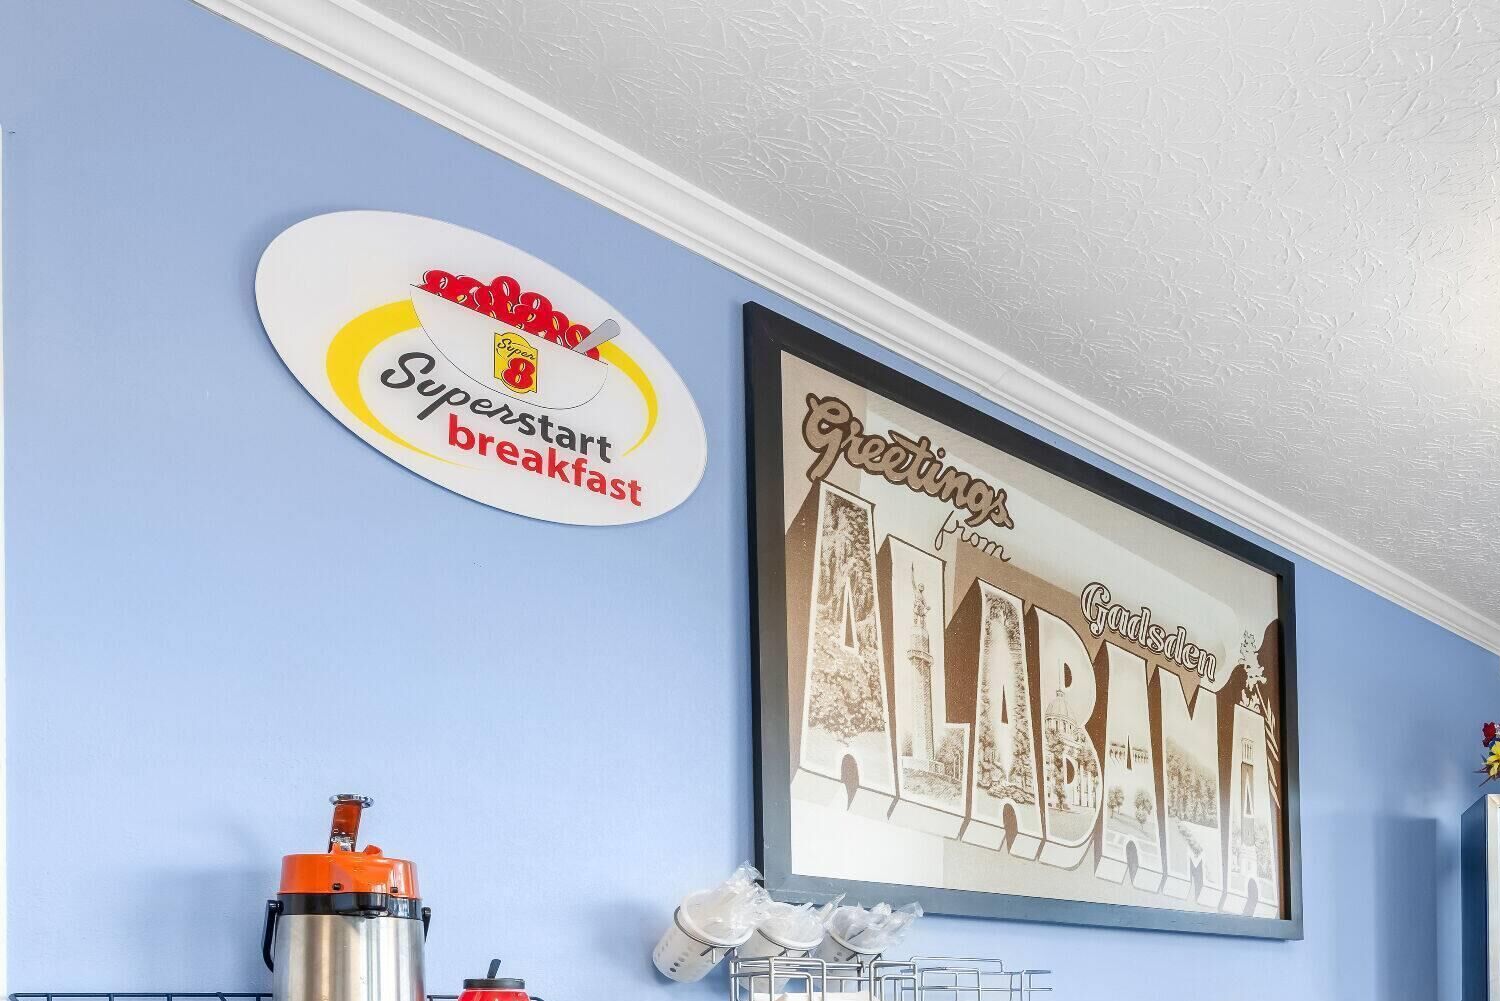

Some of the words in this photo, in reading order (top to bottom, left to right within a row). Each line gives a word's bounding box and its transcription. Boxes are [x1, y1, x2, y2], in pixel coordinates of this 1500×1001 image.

[497, 338, 536, 360] Super
[501, 357, 536, 390] 8
[380, 351, 612, 464] Superstart
[448, 412, 642, 507] breakfast
[802, 392, 1015, 530] Greetings
[934, 510, 1012, 562] from
[1080, 581, 1217, 683] Gadsden
[795, 480, 1280, 912] ALABAMA
